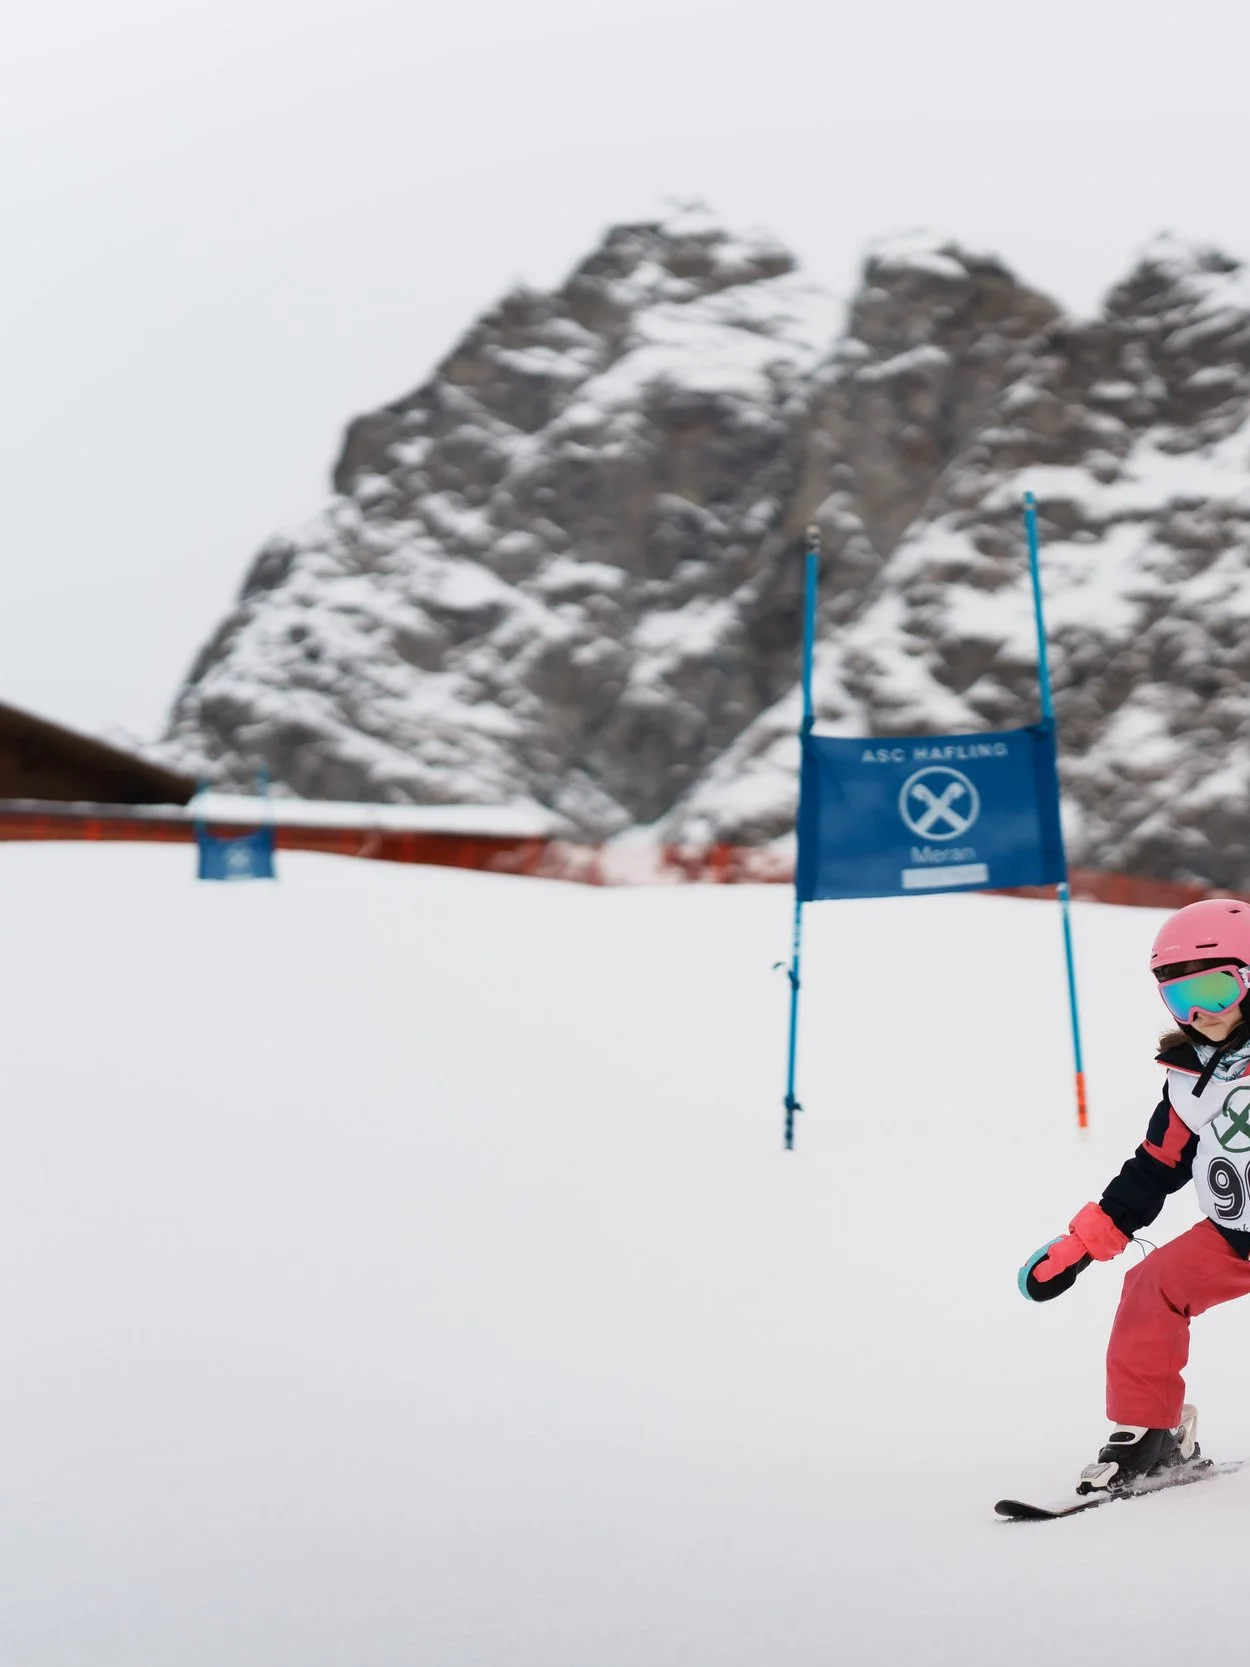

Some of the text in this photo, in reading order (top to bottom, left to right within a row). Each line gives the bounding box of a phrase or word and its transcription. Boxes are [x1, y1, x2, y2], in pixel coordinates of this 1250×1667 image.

[861, 742, 1009, 762] ASC HAFLING
[911, 846, 977, 864] Meran
